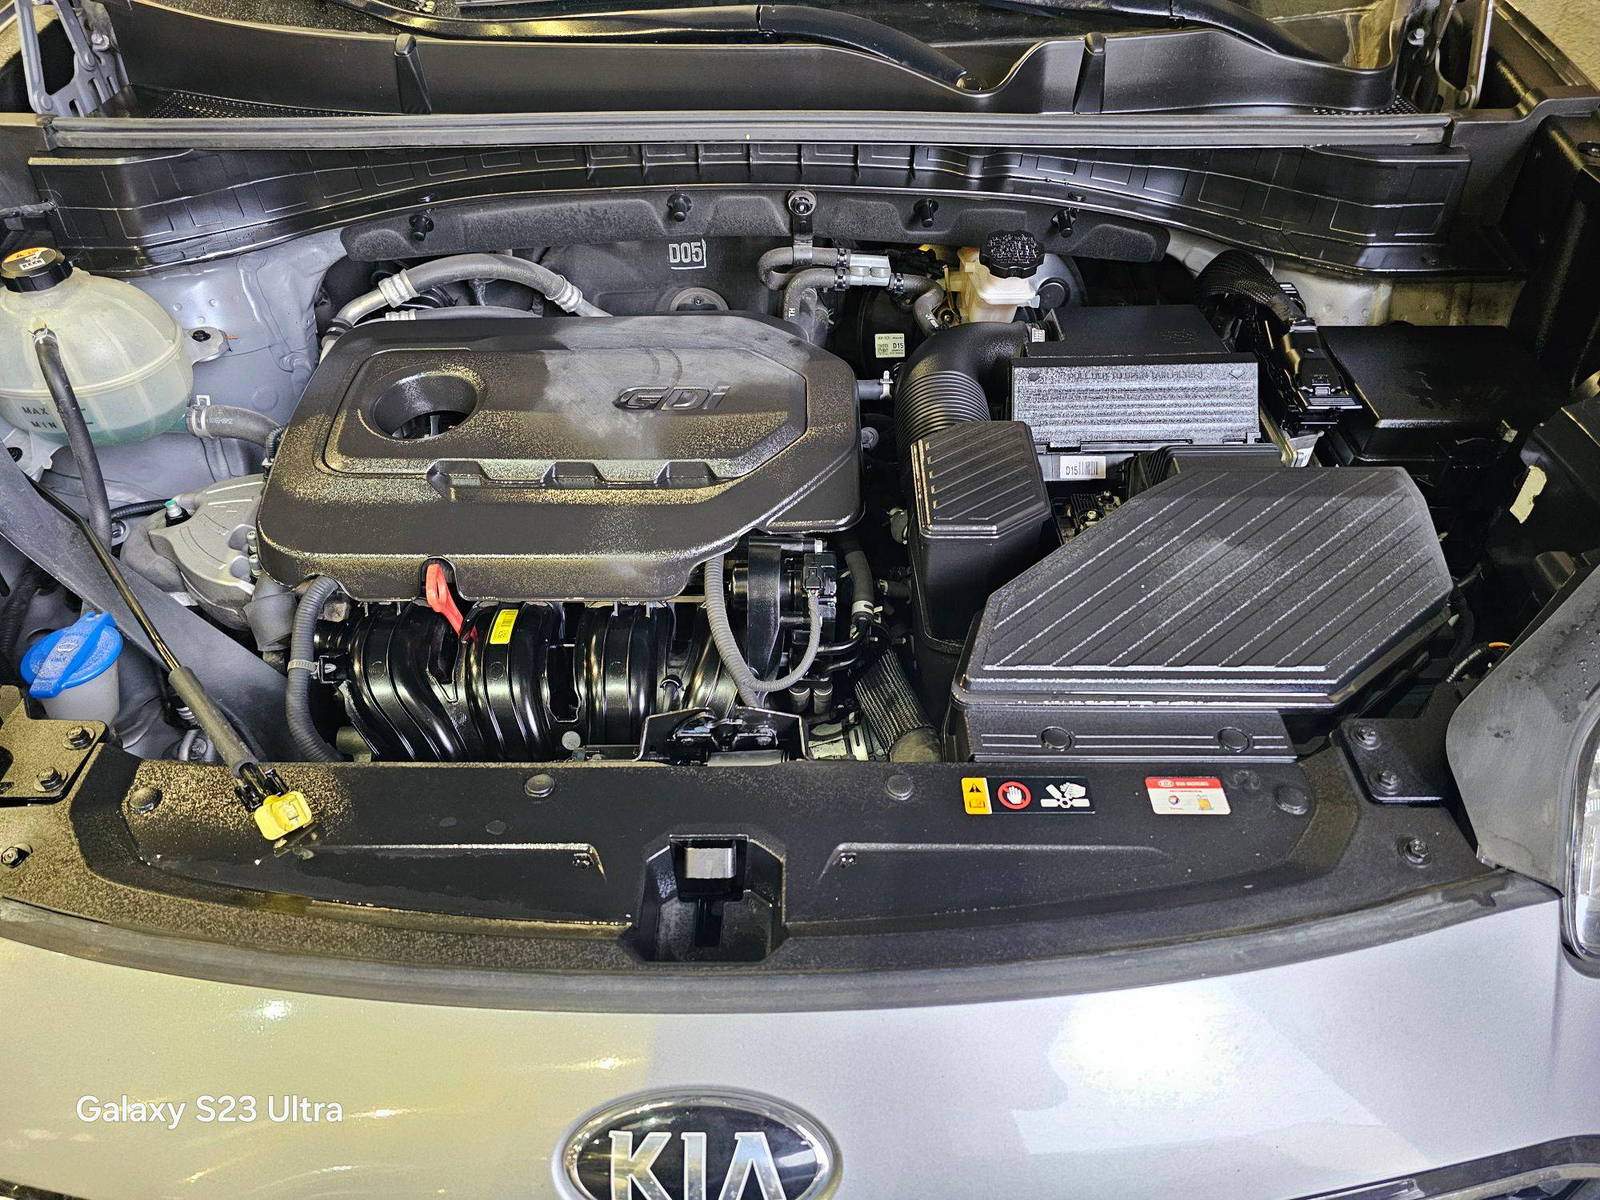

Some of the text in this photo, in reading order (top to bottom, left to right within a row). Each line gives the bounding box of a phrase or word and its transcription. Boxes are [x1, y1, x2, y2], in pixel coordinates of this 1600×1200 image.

[668, 241, 703, 264] D05
[21, 405, 49, 416] MAX
[30, 420, 58, 429] MIN
[608, 1130, 787, 1200] KIA
